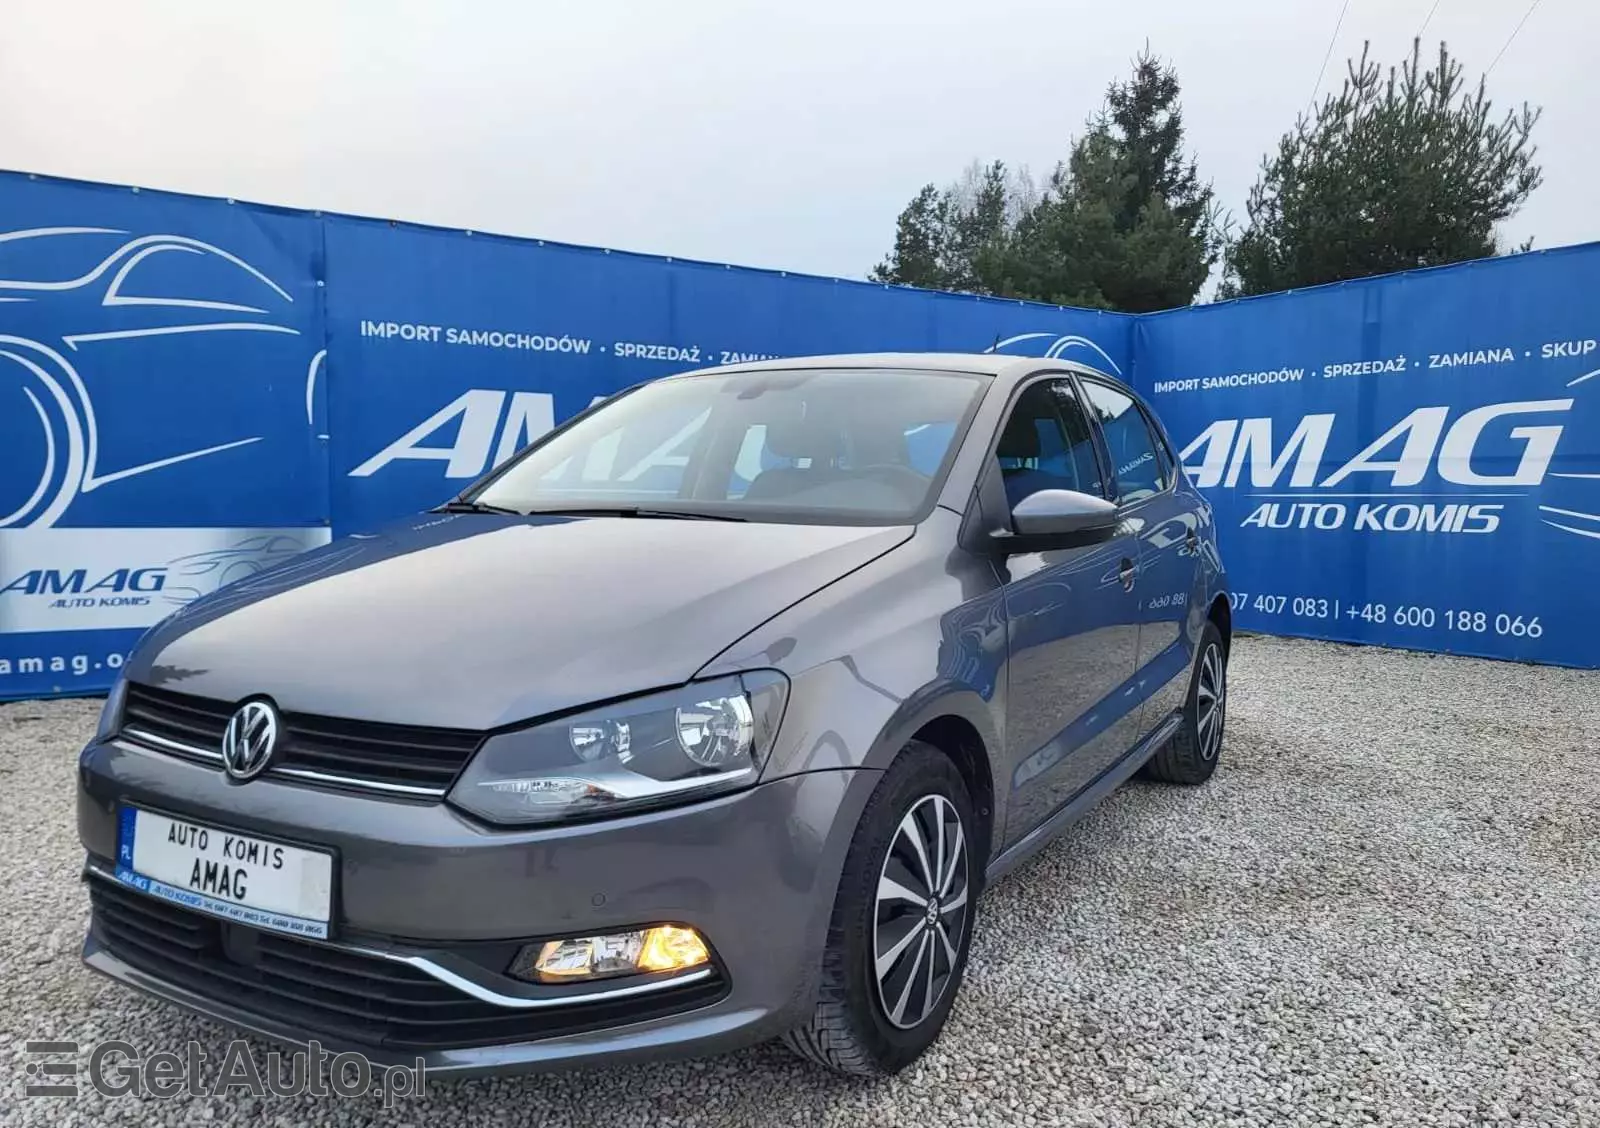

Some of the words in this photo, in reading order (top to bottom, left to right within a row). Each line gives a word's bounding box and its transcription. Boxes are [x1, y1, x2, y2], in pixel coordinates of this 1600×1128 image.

[360, 320, 441, 343] IMPORT
[445, 328, 591, 355] SAMOCHODÓW
[614, 342, 701, 362] SPRZEDAŻ
[1154, 379, 1200, 393] IMPORT
[1202, 368, 1304, 390] SAMOCHODÓW
[1323, 355, 1406, 378] SPRZEDAŻ
[1428, 348, 1514, 369] ZAMIANA
[1541, 339, 1597, 359] SKUP
[1240, 503, 1347, 530] AUTO
[1353, 504, 1504, 533] KOMIS
[48, 597, 95, 608] AUTO
[99, 596, 151, 607] KOMIS
[1253, 594, 1286, 614] 407
[1293, 597, 1329, 618] 083
[1345, 603, 1387, 624] +48
[1393, 606, 1436, 628] 600
[1445, 610, 1487, 632] 188
[1495, 613, 1543, 638] 066
[168, 822, 208, 851] AUTO
[223, 836, 285, 870] KOMIS
[190, 858, 248, 900] AMAG
